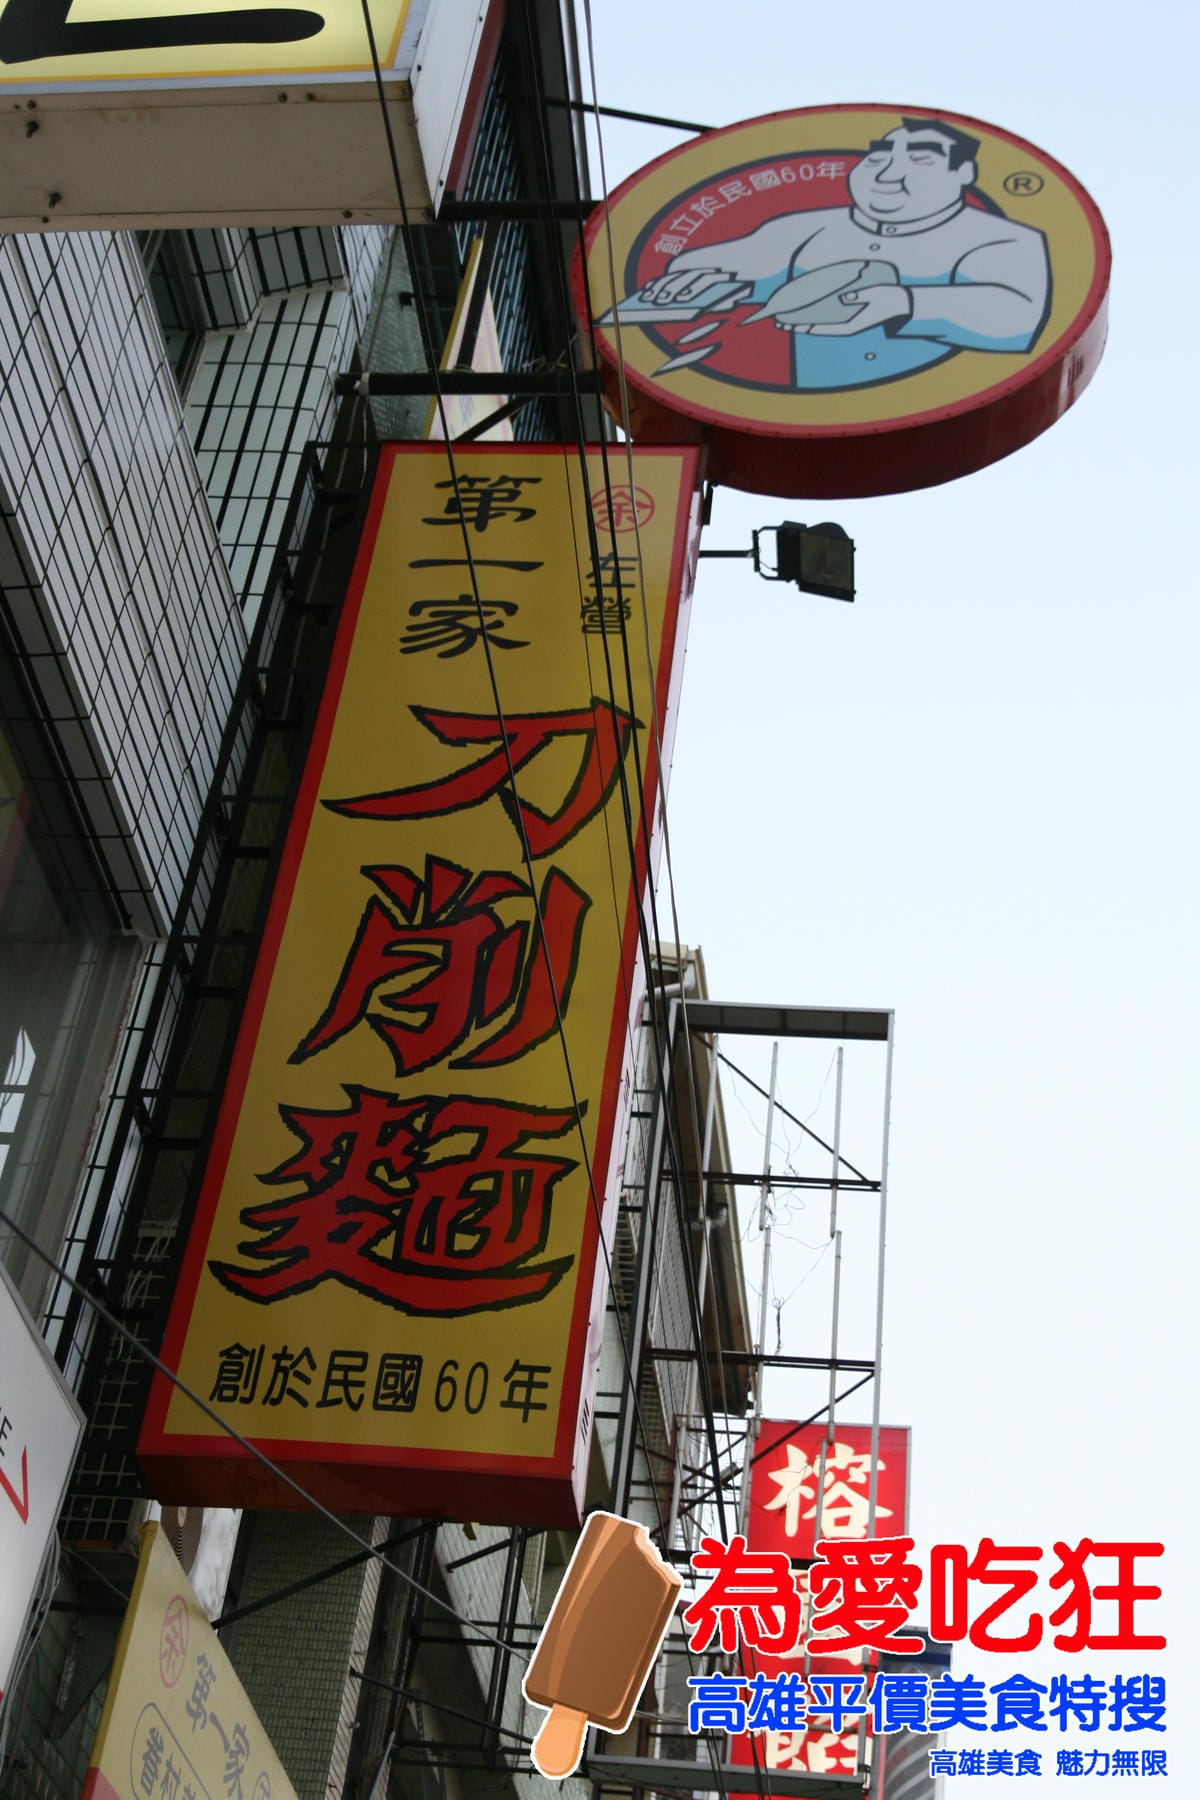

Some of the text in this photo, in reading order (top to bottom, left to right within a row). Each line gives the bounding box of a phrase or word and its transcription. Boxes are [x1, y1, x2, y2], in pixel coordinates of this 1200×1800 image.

[654, 161, 846, 256] 創立於民國60年
[398, 474, 545, 658] 第一家
[580, 551, 640, 634] 左營
[207, 696, 646, 1318] 刀削麵
